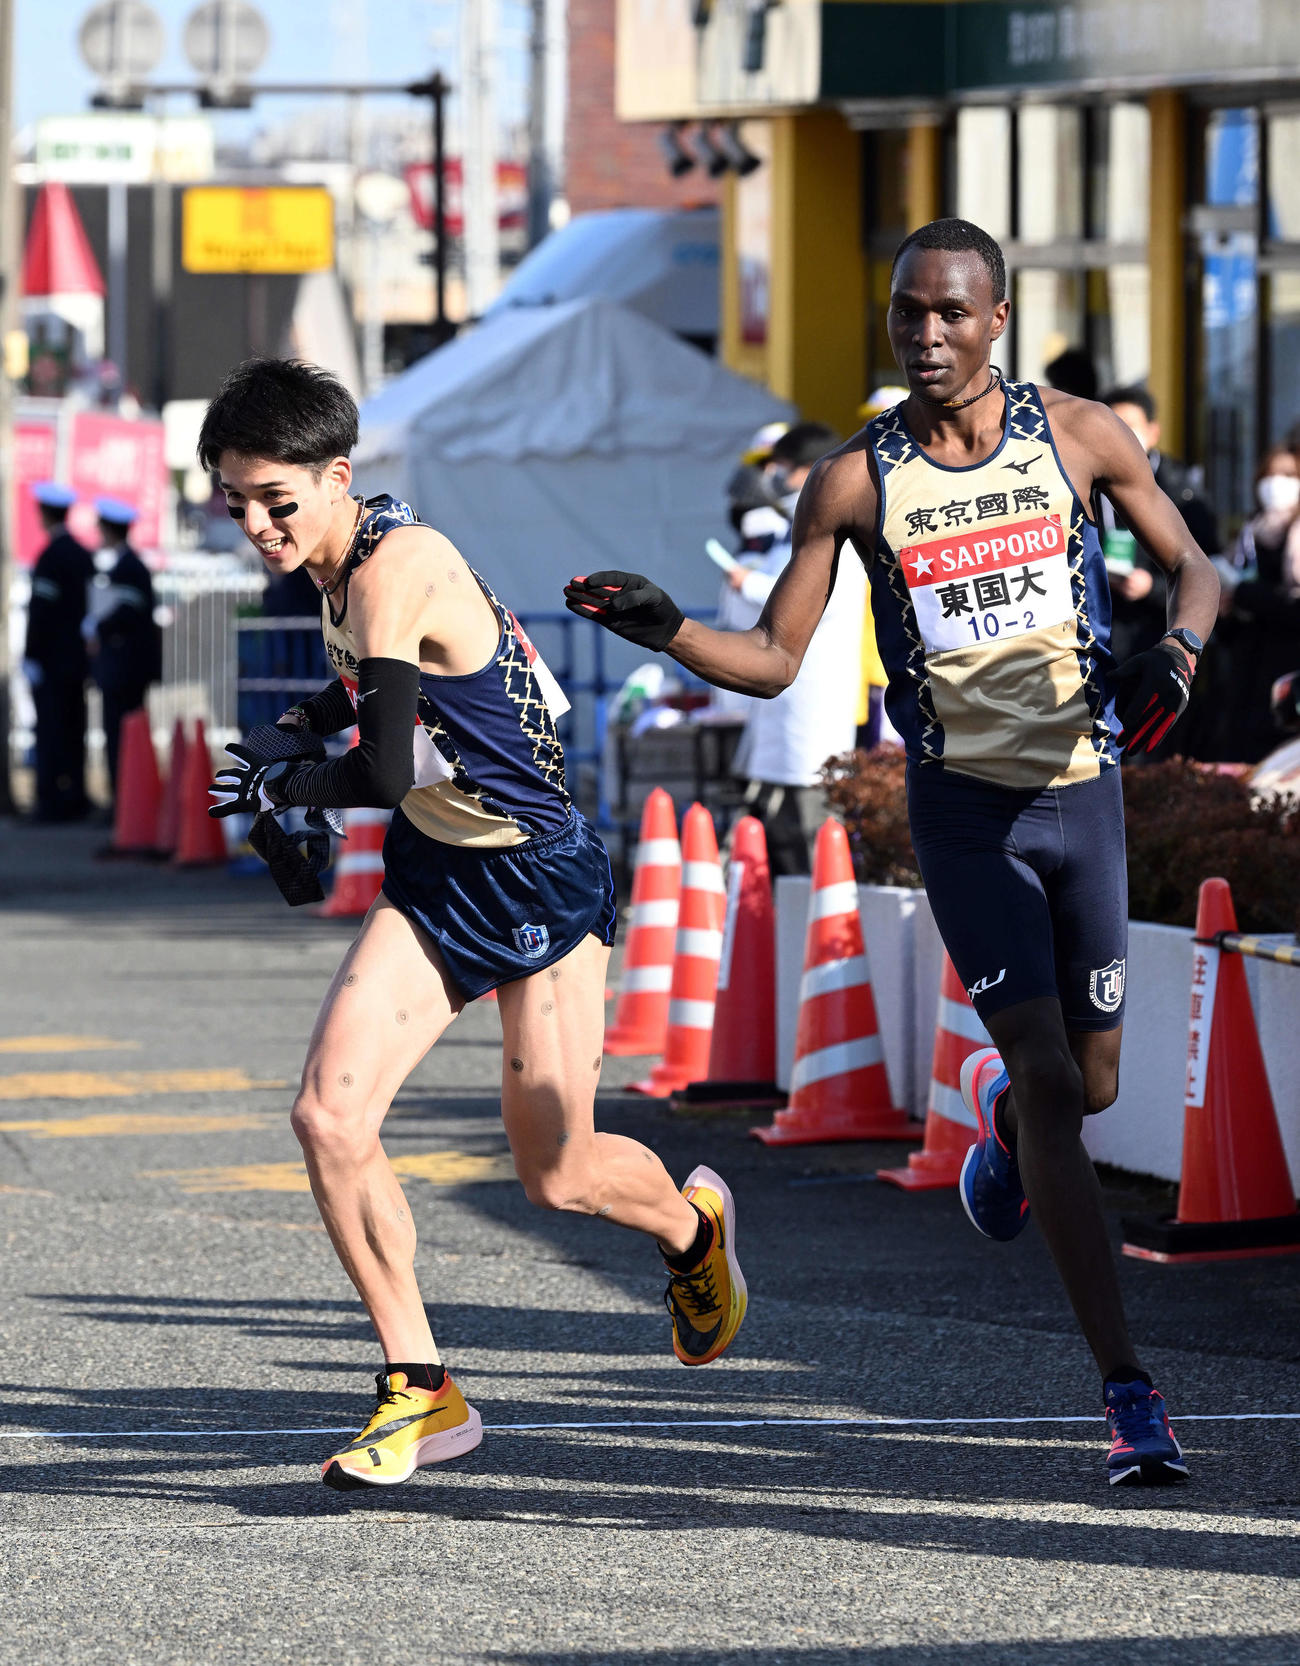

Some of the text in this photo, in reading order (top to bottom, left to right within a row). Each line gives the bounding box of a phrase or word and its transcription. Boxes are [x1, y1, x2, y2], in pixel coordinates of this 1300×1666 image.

[905, 485, 1050, 536] 東京國際
[939, 525, 1058, 573] SAPPORO
[934, 564, 1048, 619] 東国大
[967, 609, 1036, 641] 10-2
